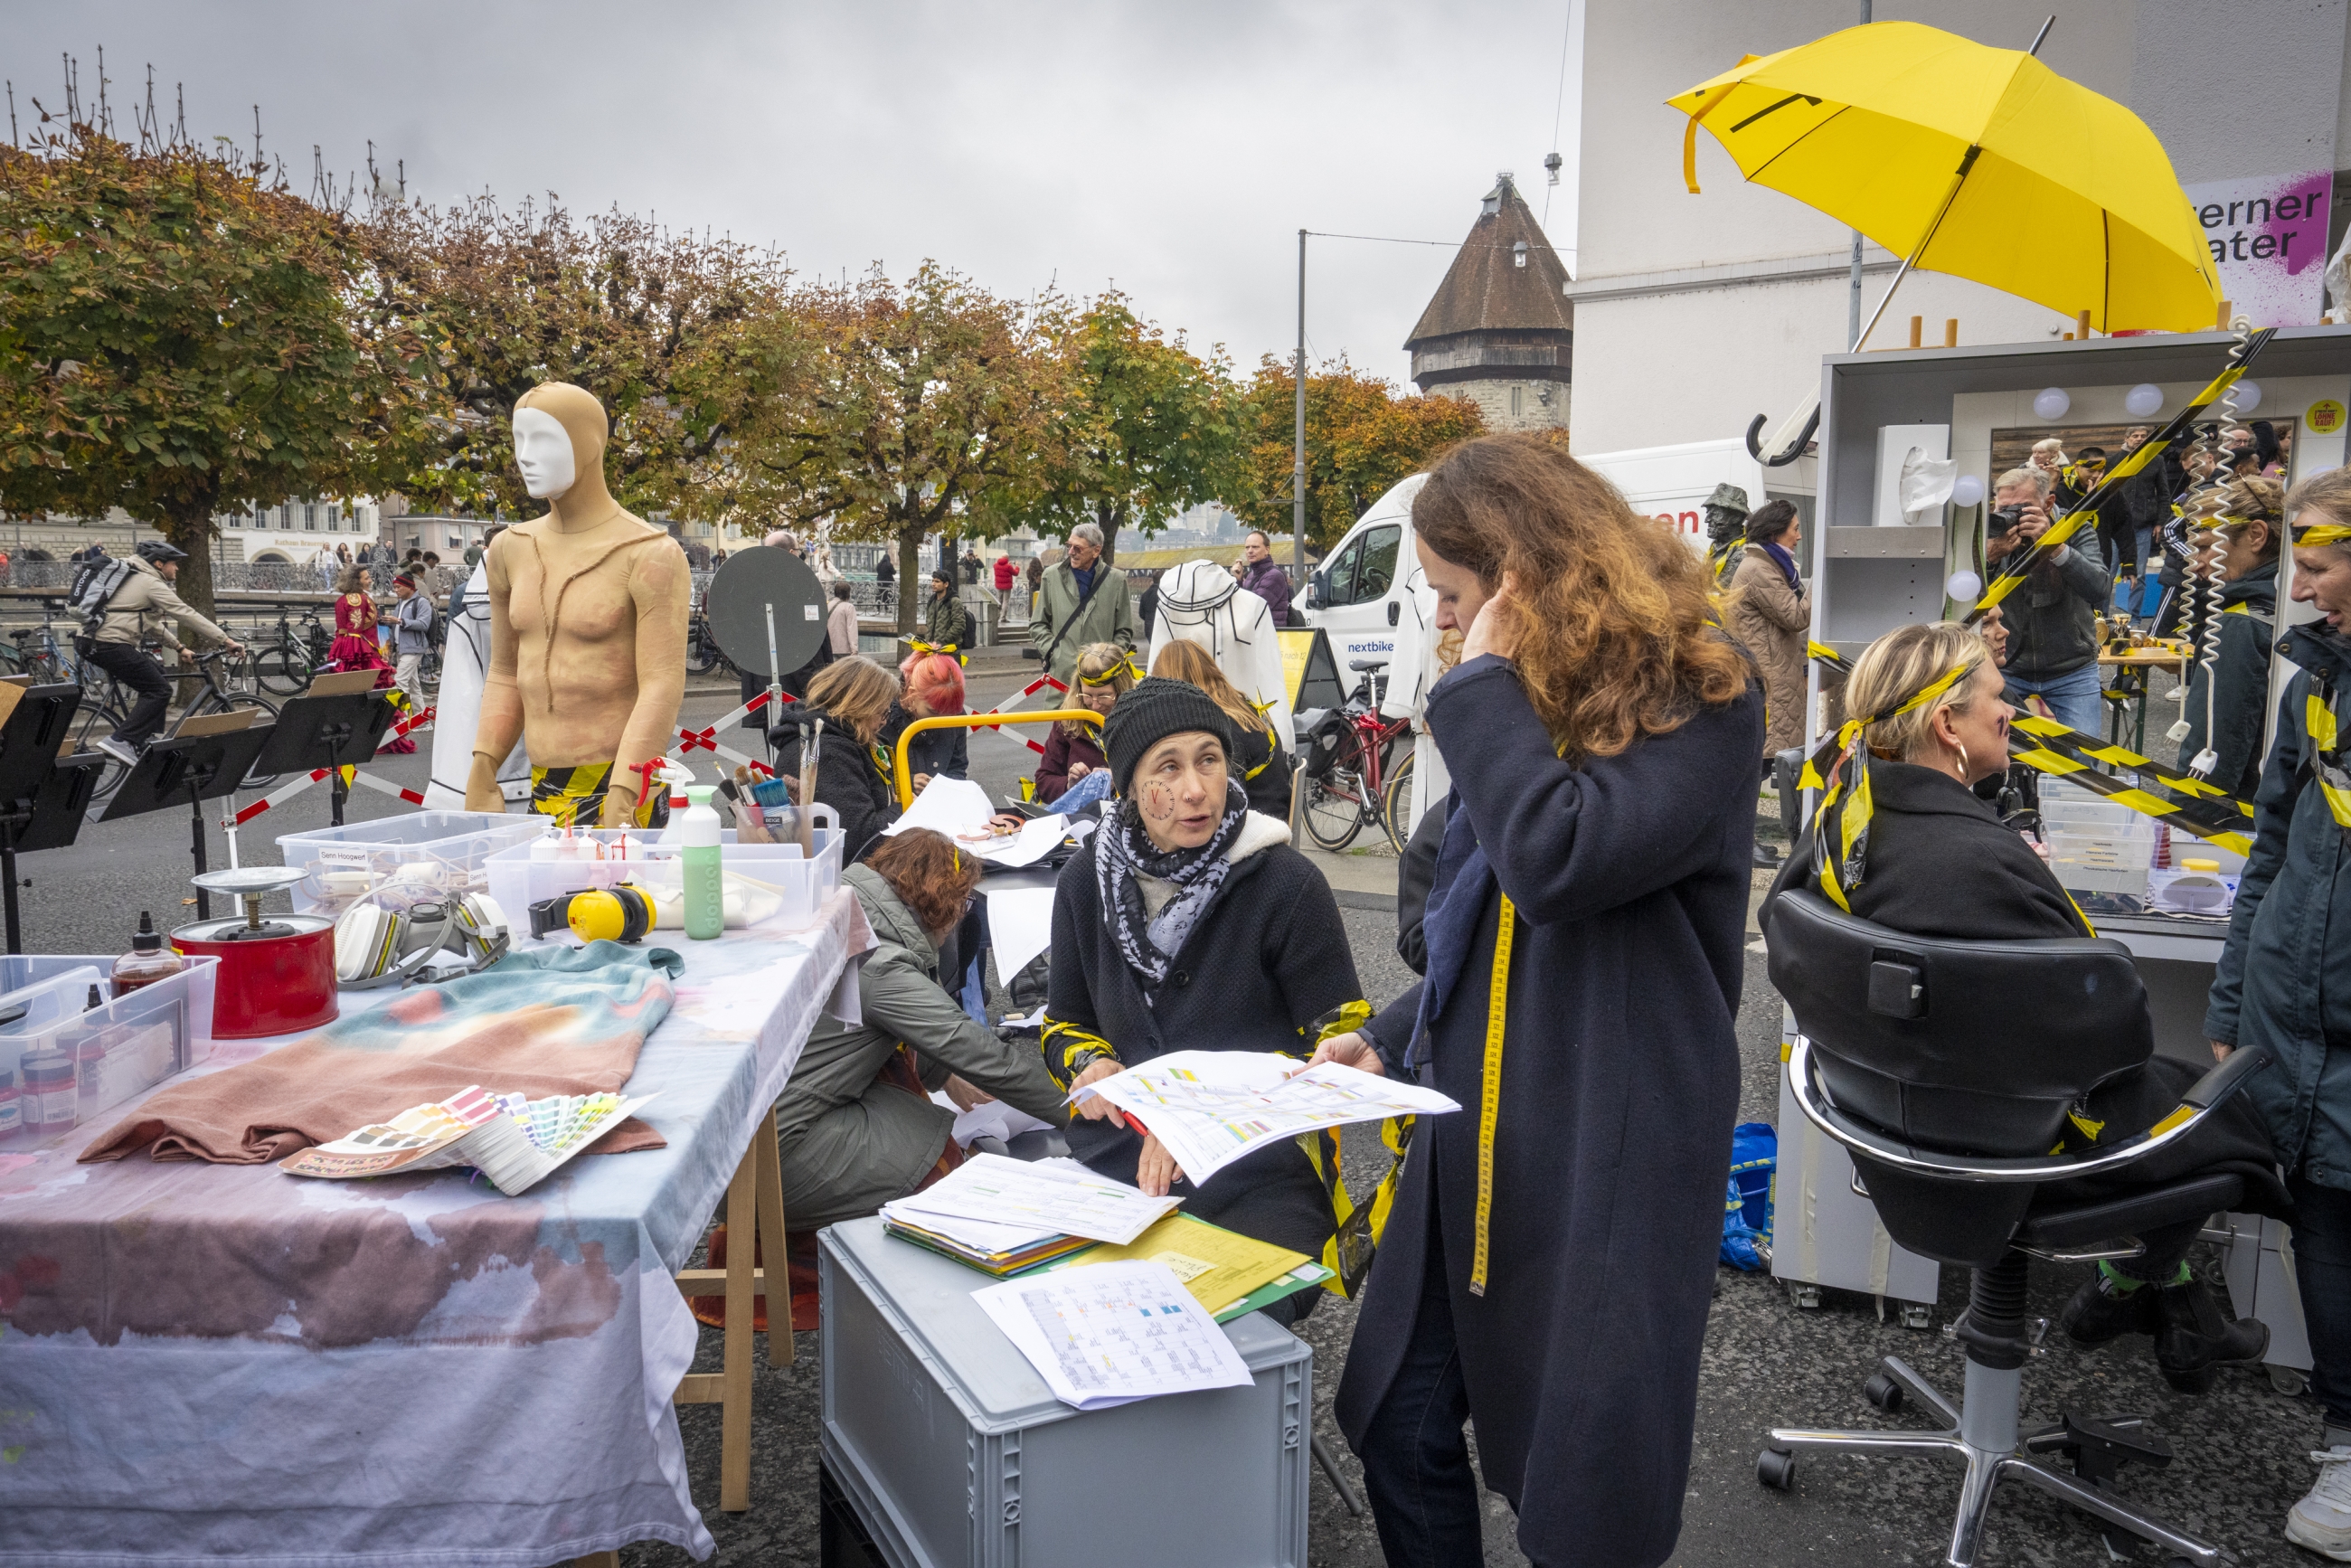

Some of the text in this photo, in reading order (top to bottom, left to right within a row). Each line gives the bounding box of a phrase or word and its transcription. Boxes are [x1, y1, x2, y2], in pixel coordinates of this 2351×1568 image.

[2193, 192, 2323, 229] erner
[73, 568, 91, 597] ORTOVOX
[1284, 651, 1298, 660] nach
[1299, 651, 1307, 660] 12
[1348, 640, 1394, 652] nextbike
[705, 851, 720, 930] dopper
